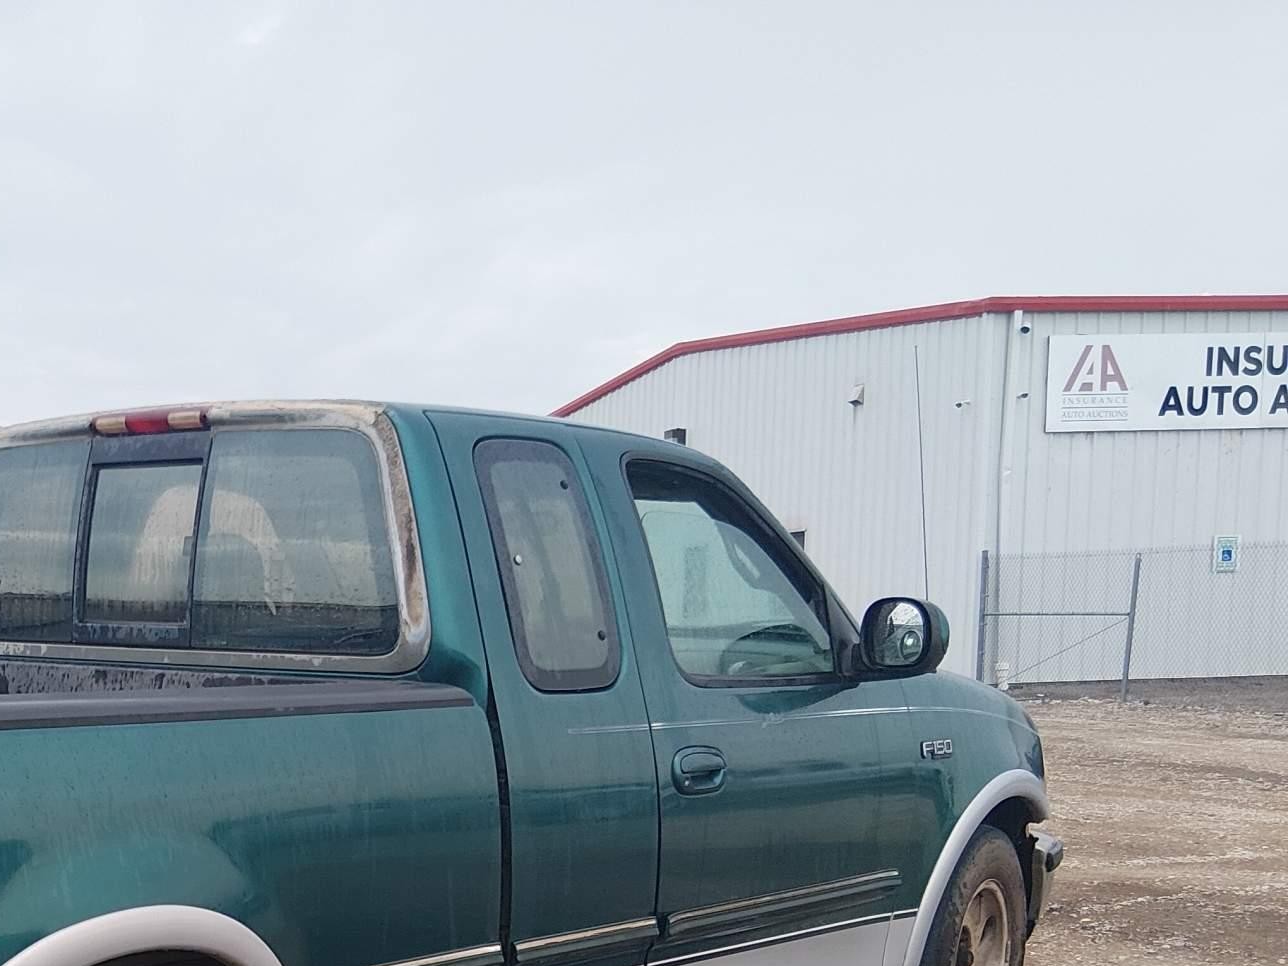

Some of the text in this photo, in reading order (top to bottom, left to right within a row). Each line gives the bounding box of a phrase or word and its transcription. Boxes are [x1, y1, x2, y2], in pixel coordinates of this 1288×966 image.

[1205, 345, 1288, 377] INSU
[1063, 396, 1128, 405] INSURANCE
[1158, 384, 1288, 416] AUTO A
[1063, 409, 1128, 418] AUTO AUCTIONS
